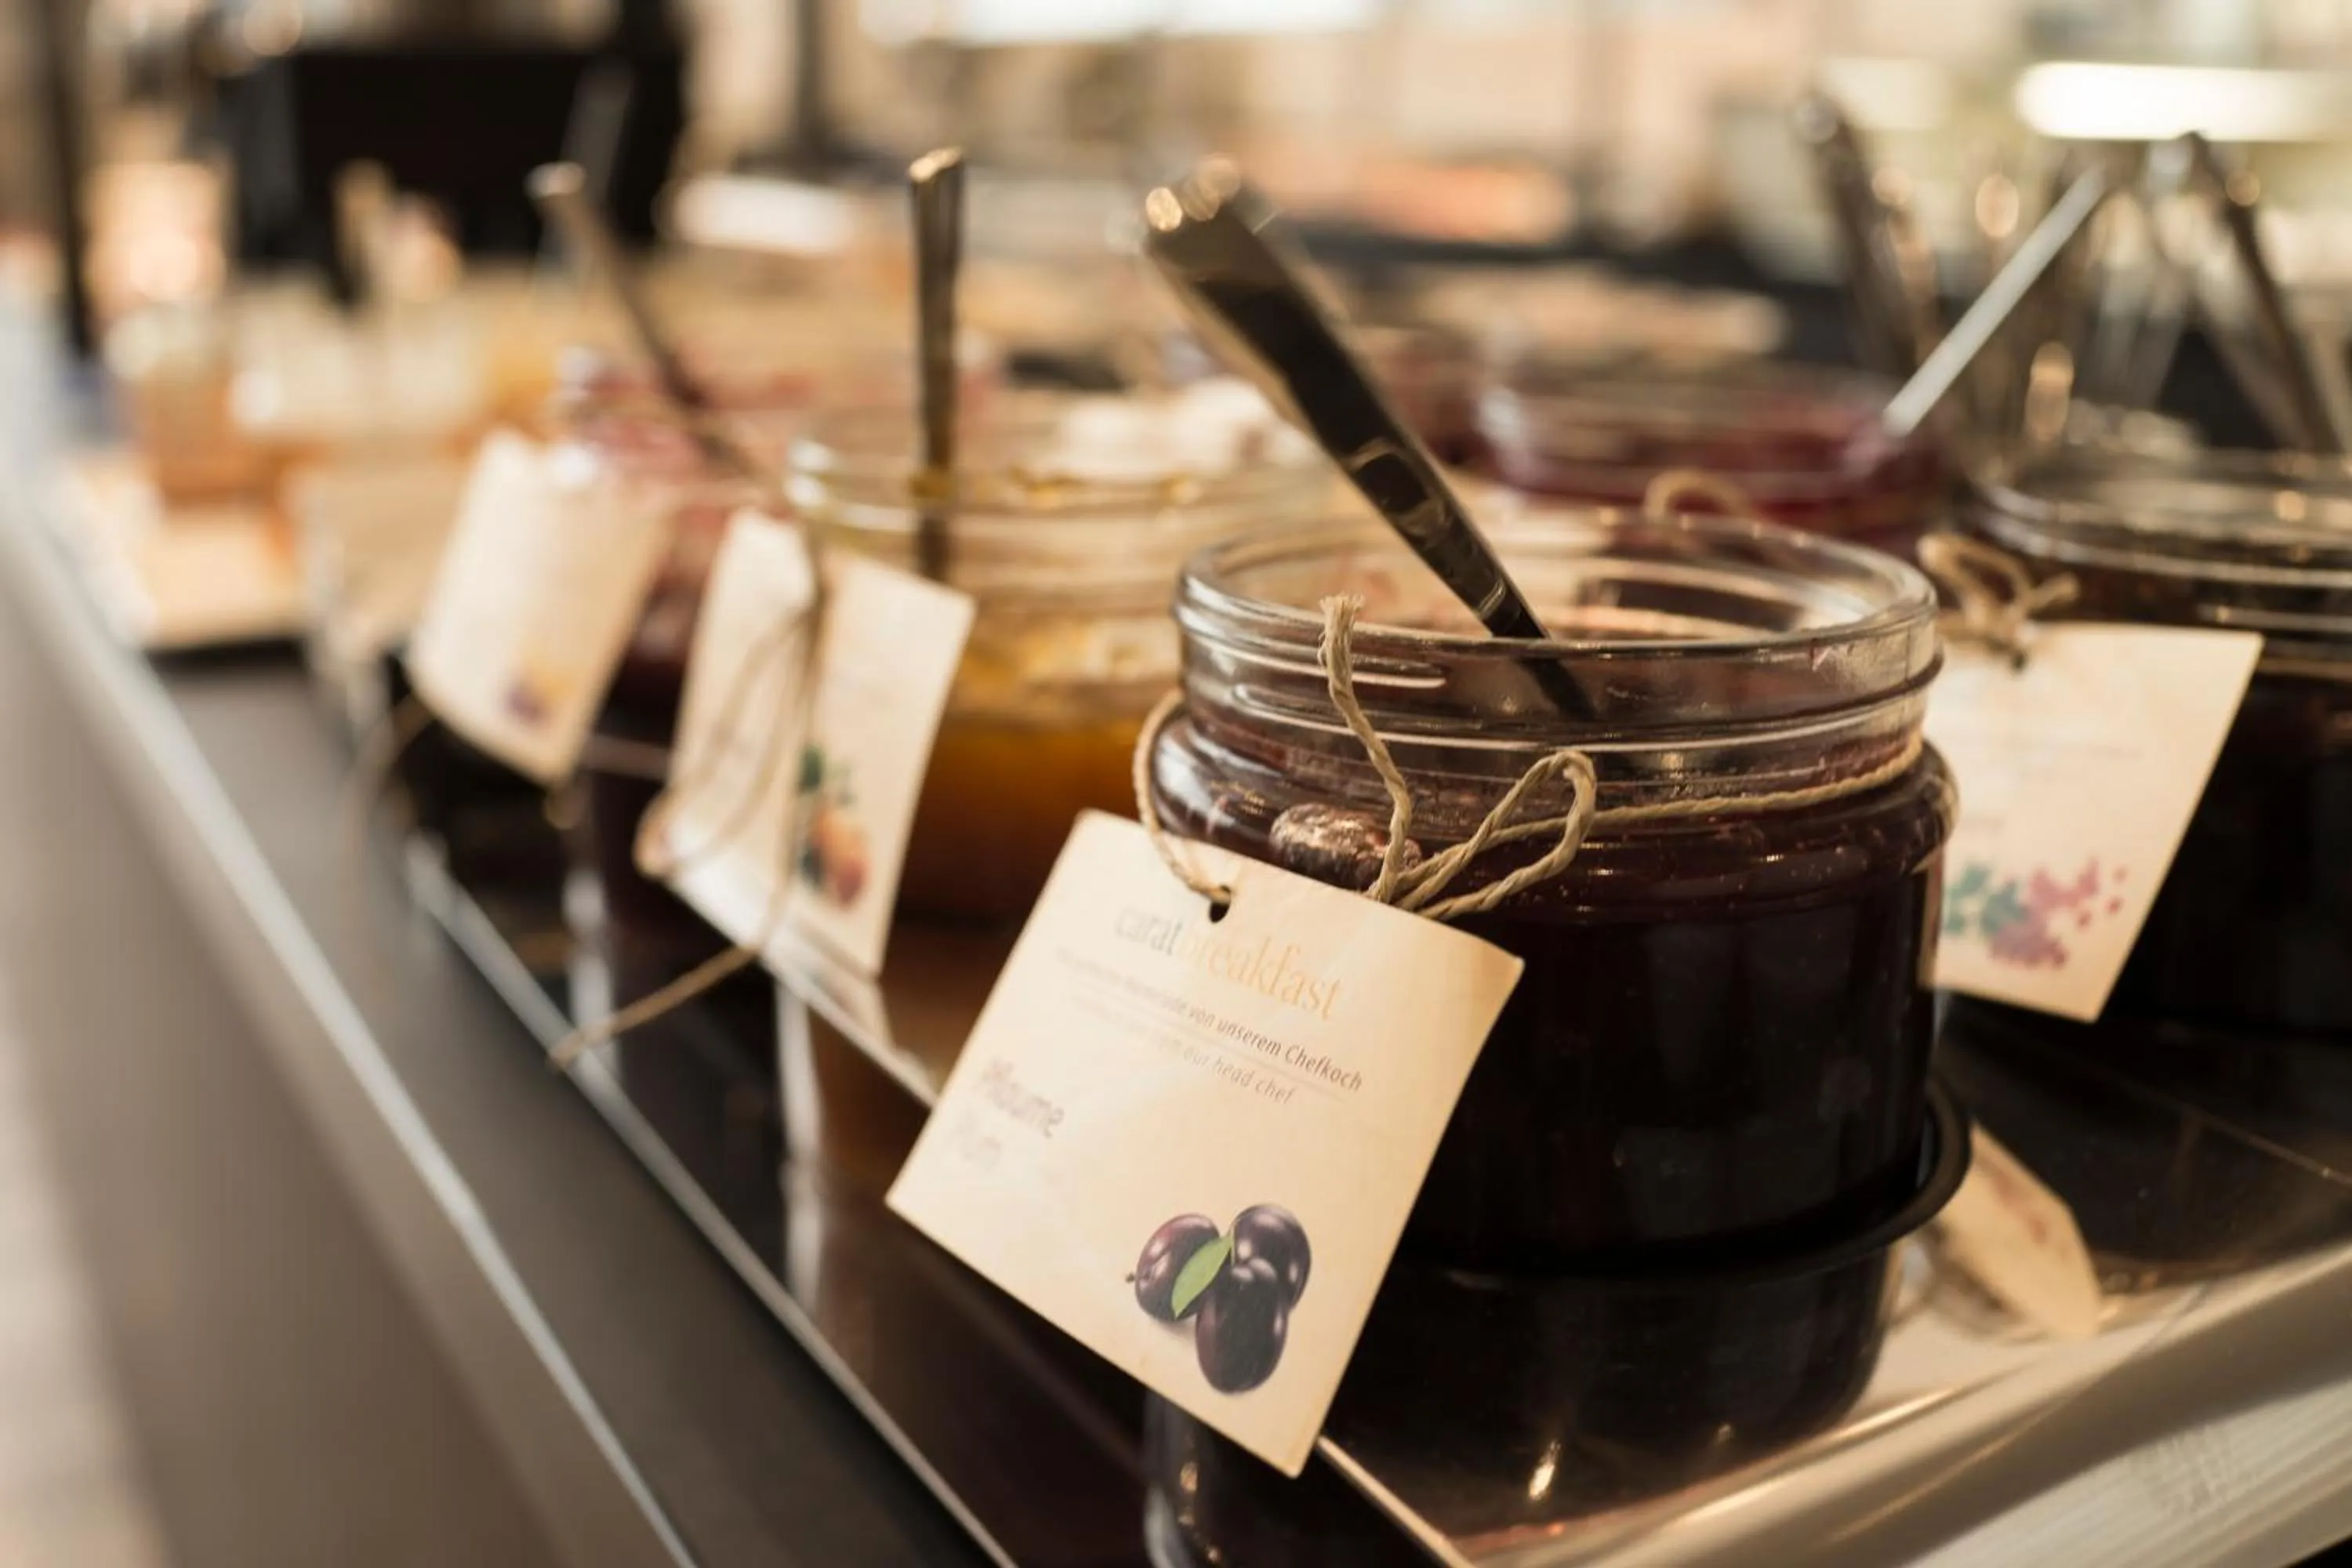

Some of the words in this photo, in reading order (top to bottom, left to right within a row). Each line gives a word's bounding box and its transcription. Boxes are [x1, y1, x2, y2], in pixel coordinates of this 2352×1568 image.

[1183, 1046, 1210, 1067] our
[1212, 1054, 1255, 1089] head
[1254, 1076, 1298, 1105] chef
[1188, 1005, 1216, 1029] von
[1215, 1017, 1283, 1057] unserem
[1284, 1043, 1364, 1092] Chefkoch
